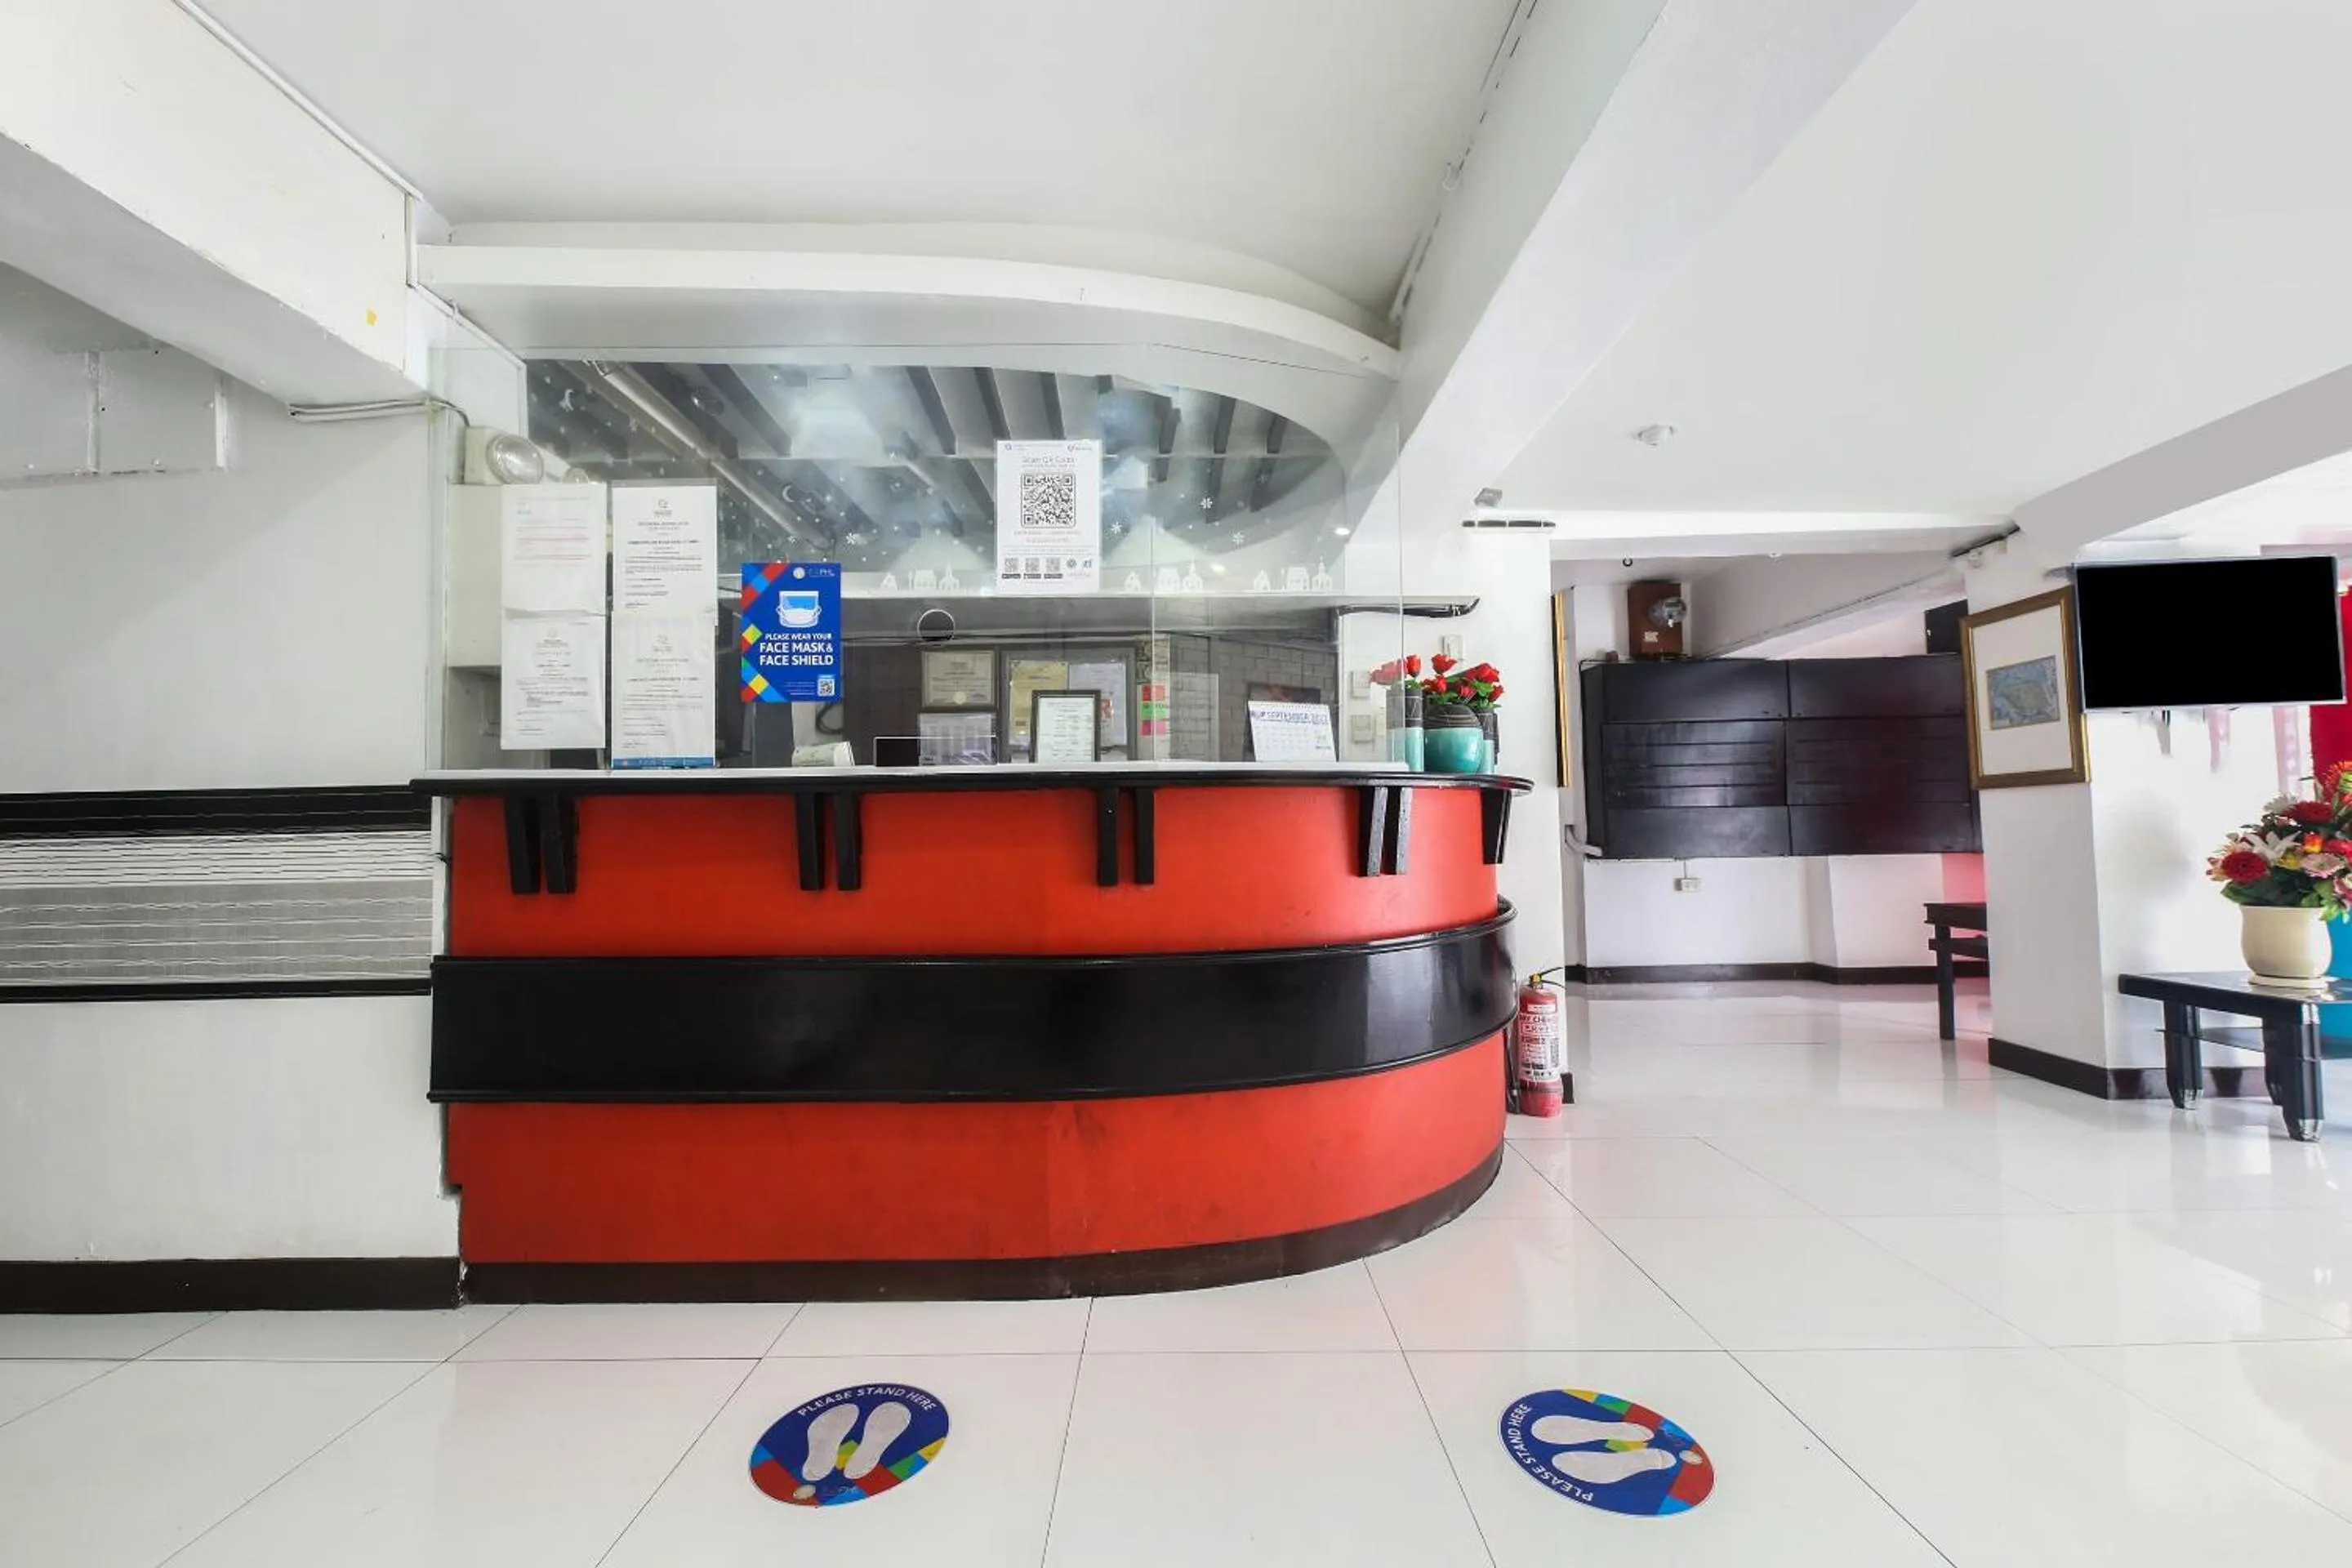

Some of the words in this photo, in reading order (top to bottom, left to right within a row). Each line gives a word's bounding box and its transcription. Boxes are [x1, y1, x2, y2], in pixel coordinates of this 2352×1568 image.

[760, 642, 789, 653] FACE
[791, 642, 824, 653] MASK
[760, 654, 789, 666] FACE
[791, 654, 834, 666] SHIELD
[797, 1390, 853, 1416] PLEASE
[857, 1387, 905, 1397] STAND
[906, 1391, 937, 1411] HERE
[1508, 1403, 1532, 1428] HERE
[1508, 1428, 1535, 1464] STAND
[1531, 1463, 1593, 1501] PLEASE
